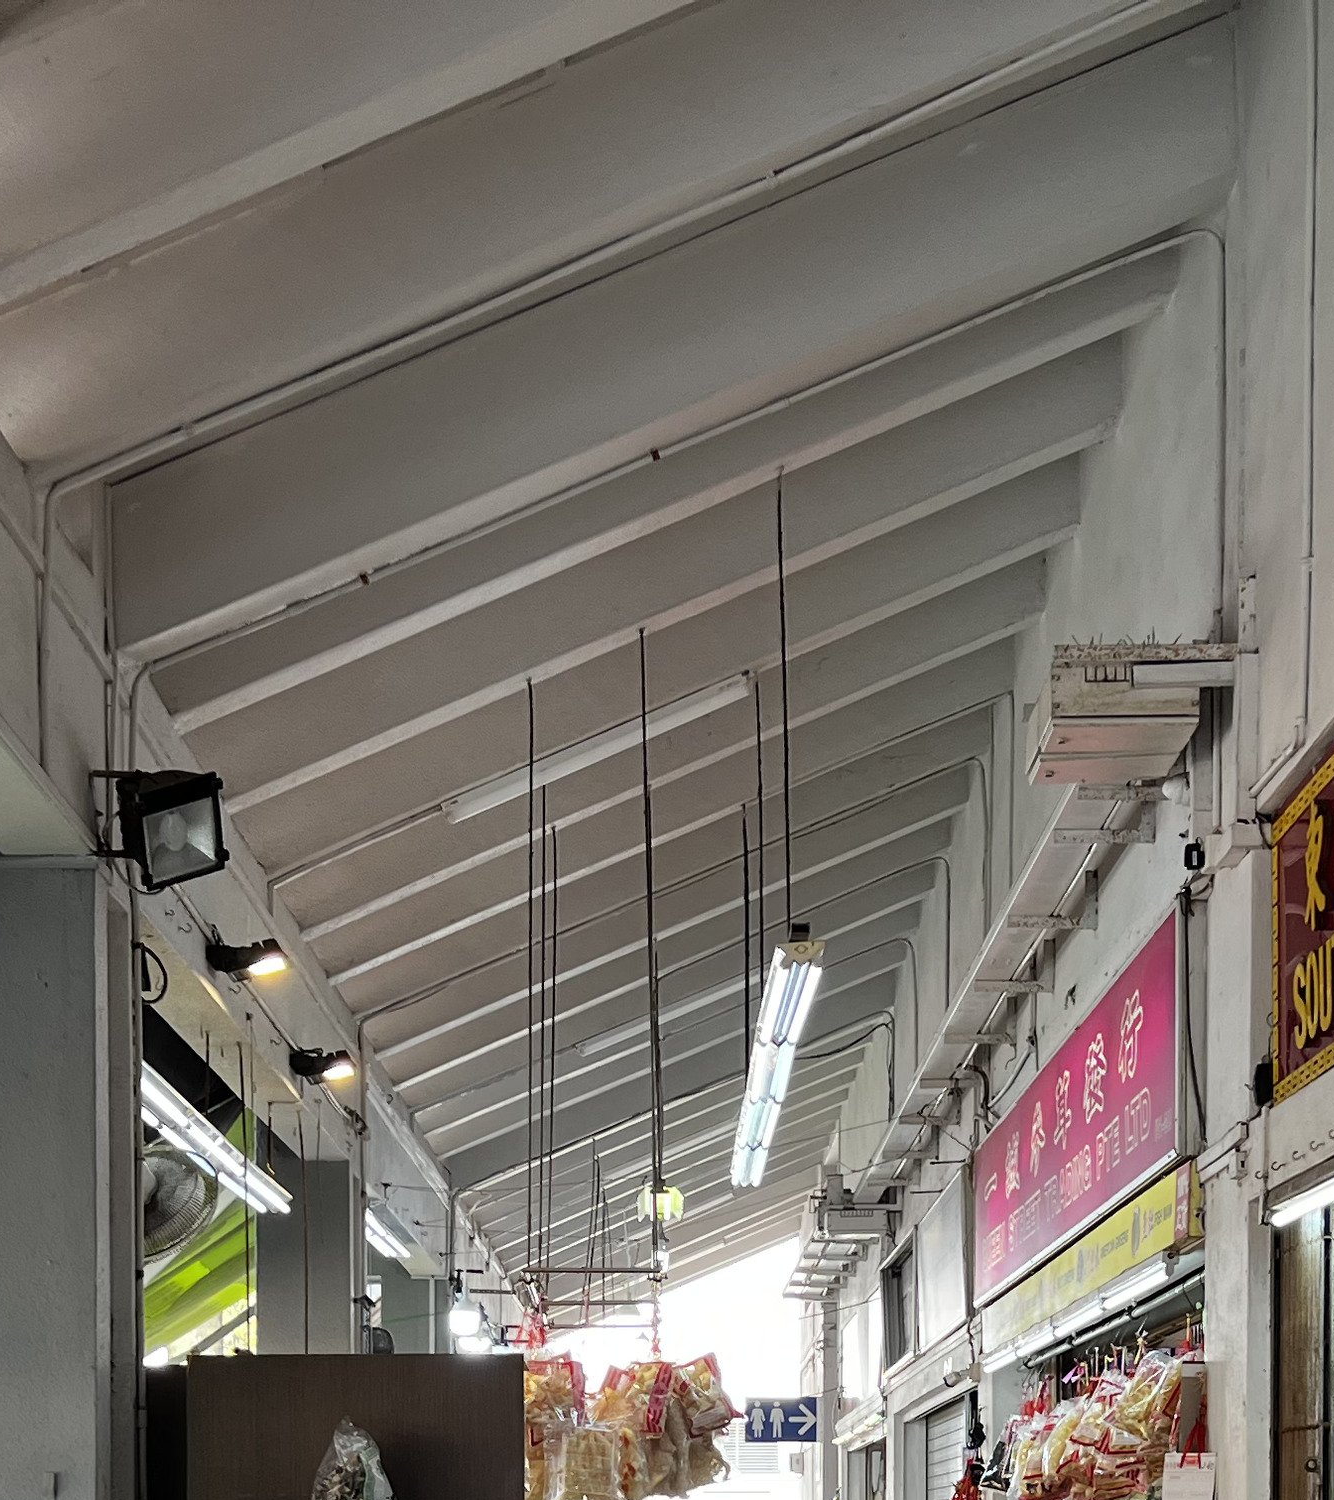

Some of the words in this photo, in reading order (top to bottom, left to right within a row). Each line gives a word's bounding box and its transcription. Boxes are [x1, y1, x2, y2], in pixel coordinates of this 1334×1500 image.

[1043, 1143, 1093, 1223] TRADING
[1096, 1114, 1121, 1182] PTE
[1124, 1087, 1152, 1157] LTD
